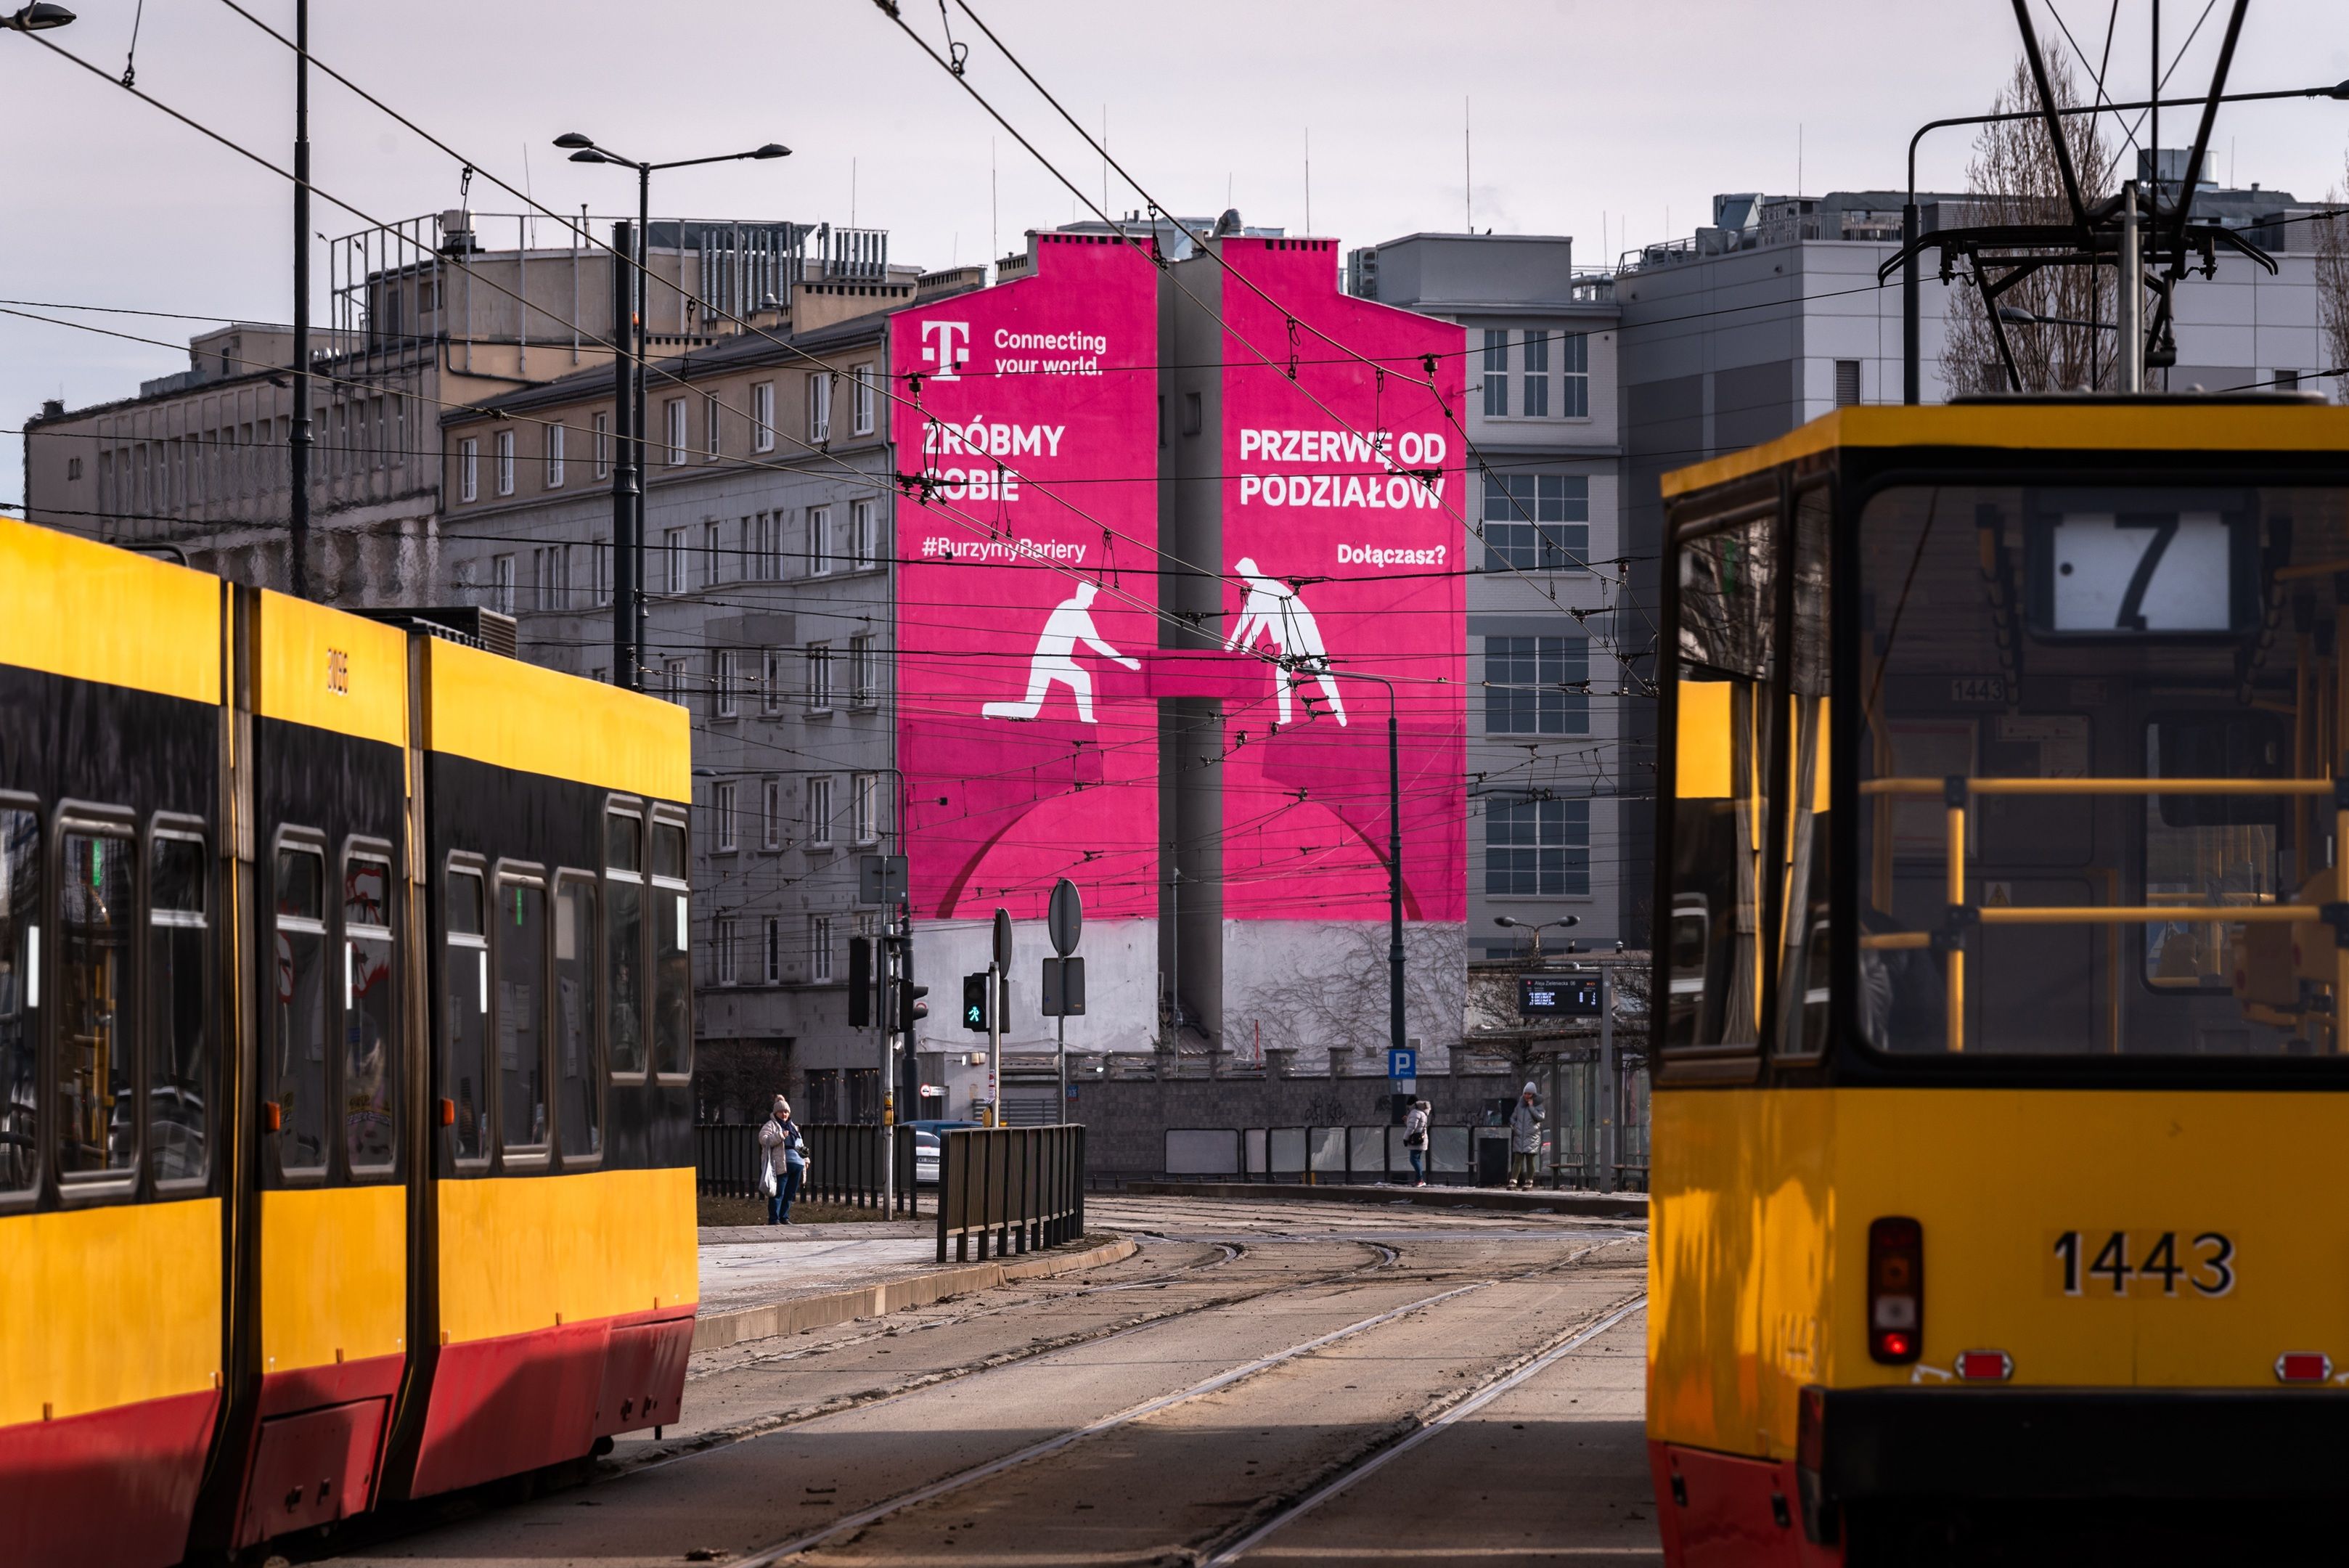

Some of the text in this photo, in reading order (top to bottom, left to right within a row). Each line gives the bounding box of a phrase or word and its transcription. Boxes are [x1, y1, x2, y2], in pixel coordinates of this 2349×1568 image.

[994, 329, 1106, 355] Connecting
[994, 356, 1103, 377] your world.
[922, 415, 1066, 457] ZRÓBMY
[1241, 428, 1447, 470] PRZERWĘ OD
[1241, 467, 1445, 509] PODZIAŁÓW
[922, 536, 1087, 563] #BurzymyBariery
[1337, 544, 1447, 568] Dołączasz?
[2114, 512, 2180, 630] 7
[1953, 680, 2003, 701] 1443
[1395, 1053, 1410, 1075] P
[2054, 1231, 2235, 1298] 1443
